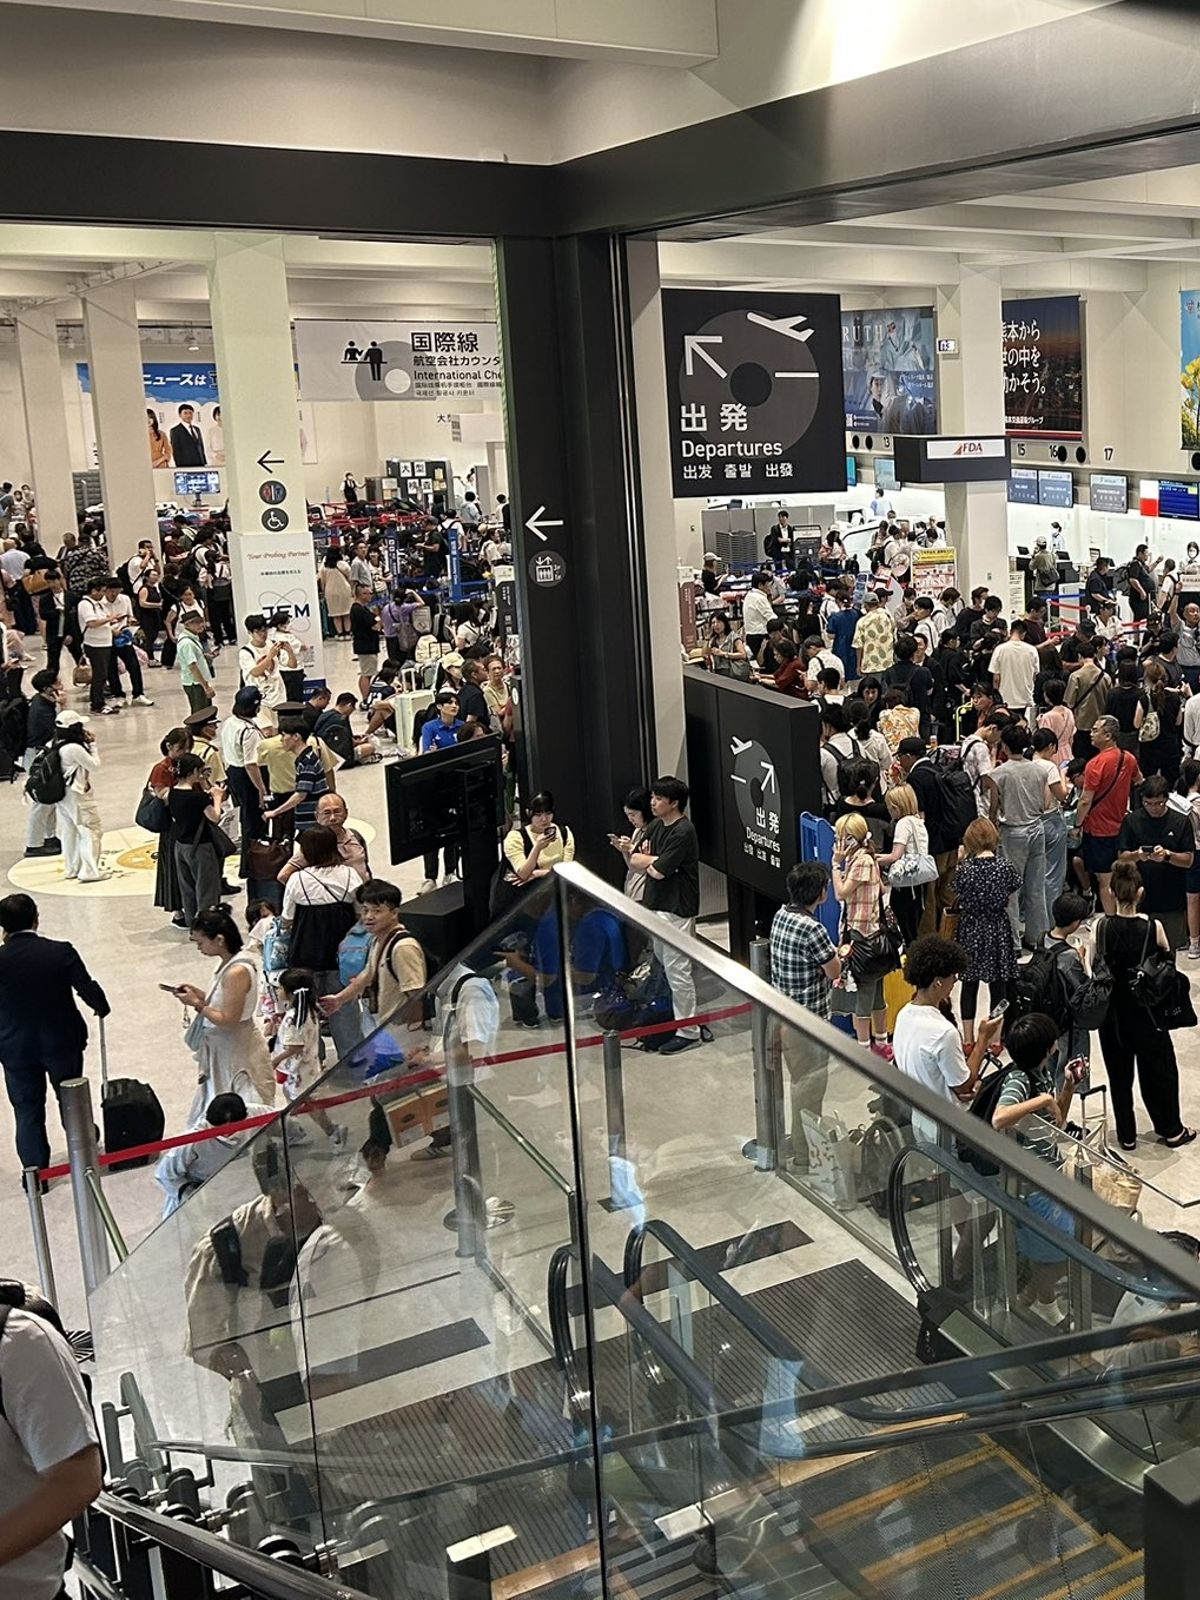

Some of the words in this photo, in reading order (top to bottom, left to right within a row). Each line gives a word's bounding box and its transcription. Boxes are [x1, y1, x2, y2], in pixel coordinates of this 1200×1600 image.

[411, 332, 479, 352] 国際線
[414, 371, 481, 380] International
[681, 403, 748, 432] 出発
[682, 440, 783, 461] Departures
[963, 442, 983, 452] FDA
[1017, 443, 1026, 456] 15
[1104, 448, 1113, 461] 17
[683, 464, 712, 480] 出发
[724, 463, 752, 479] 출발
[765, 462, 794, 478] 出發
[756, 806, 780, 834] 出発
[746, 826, 781, 853] Departures
